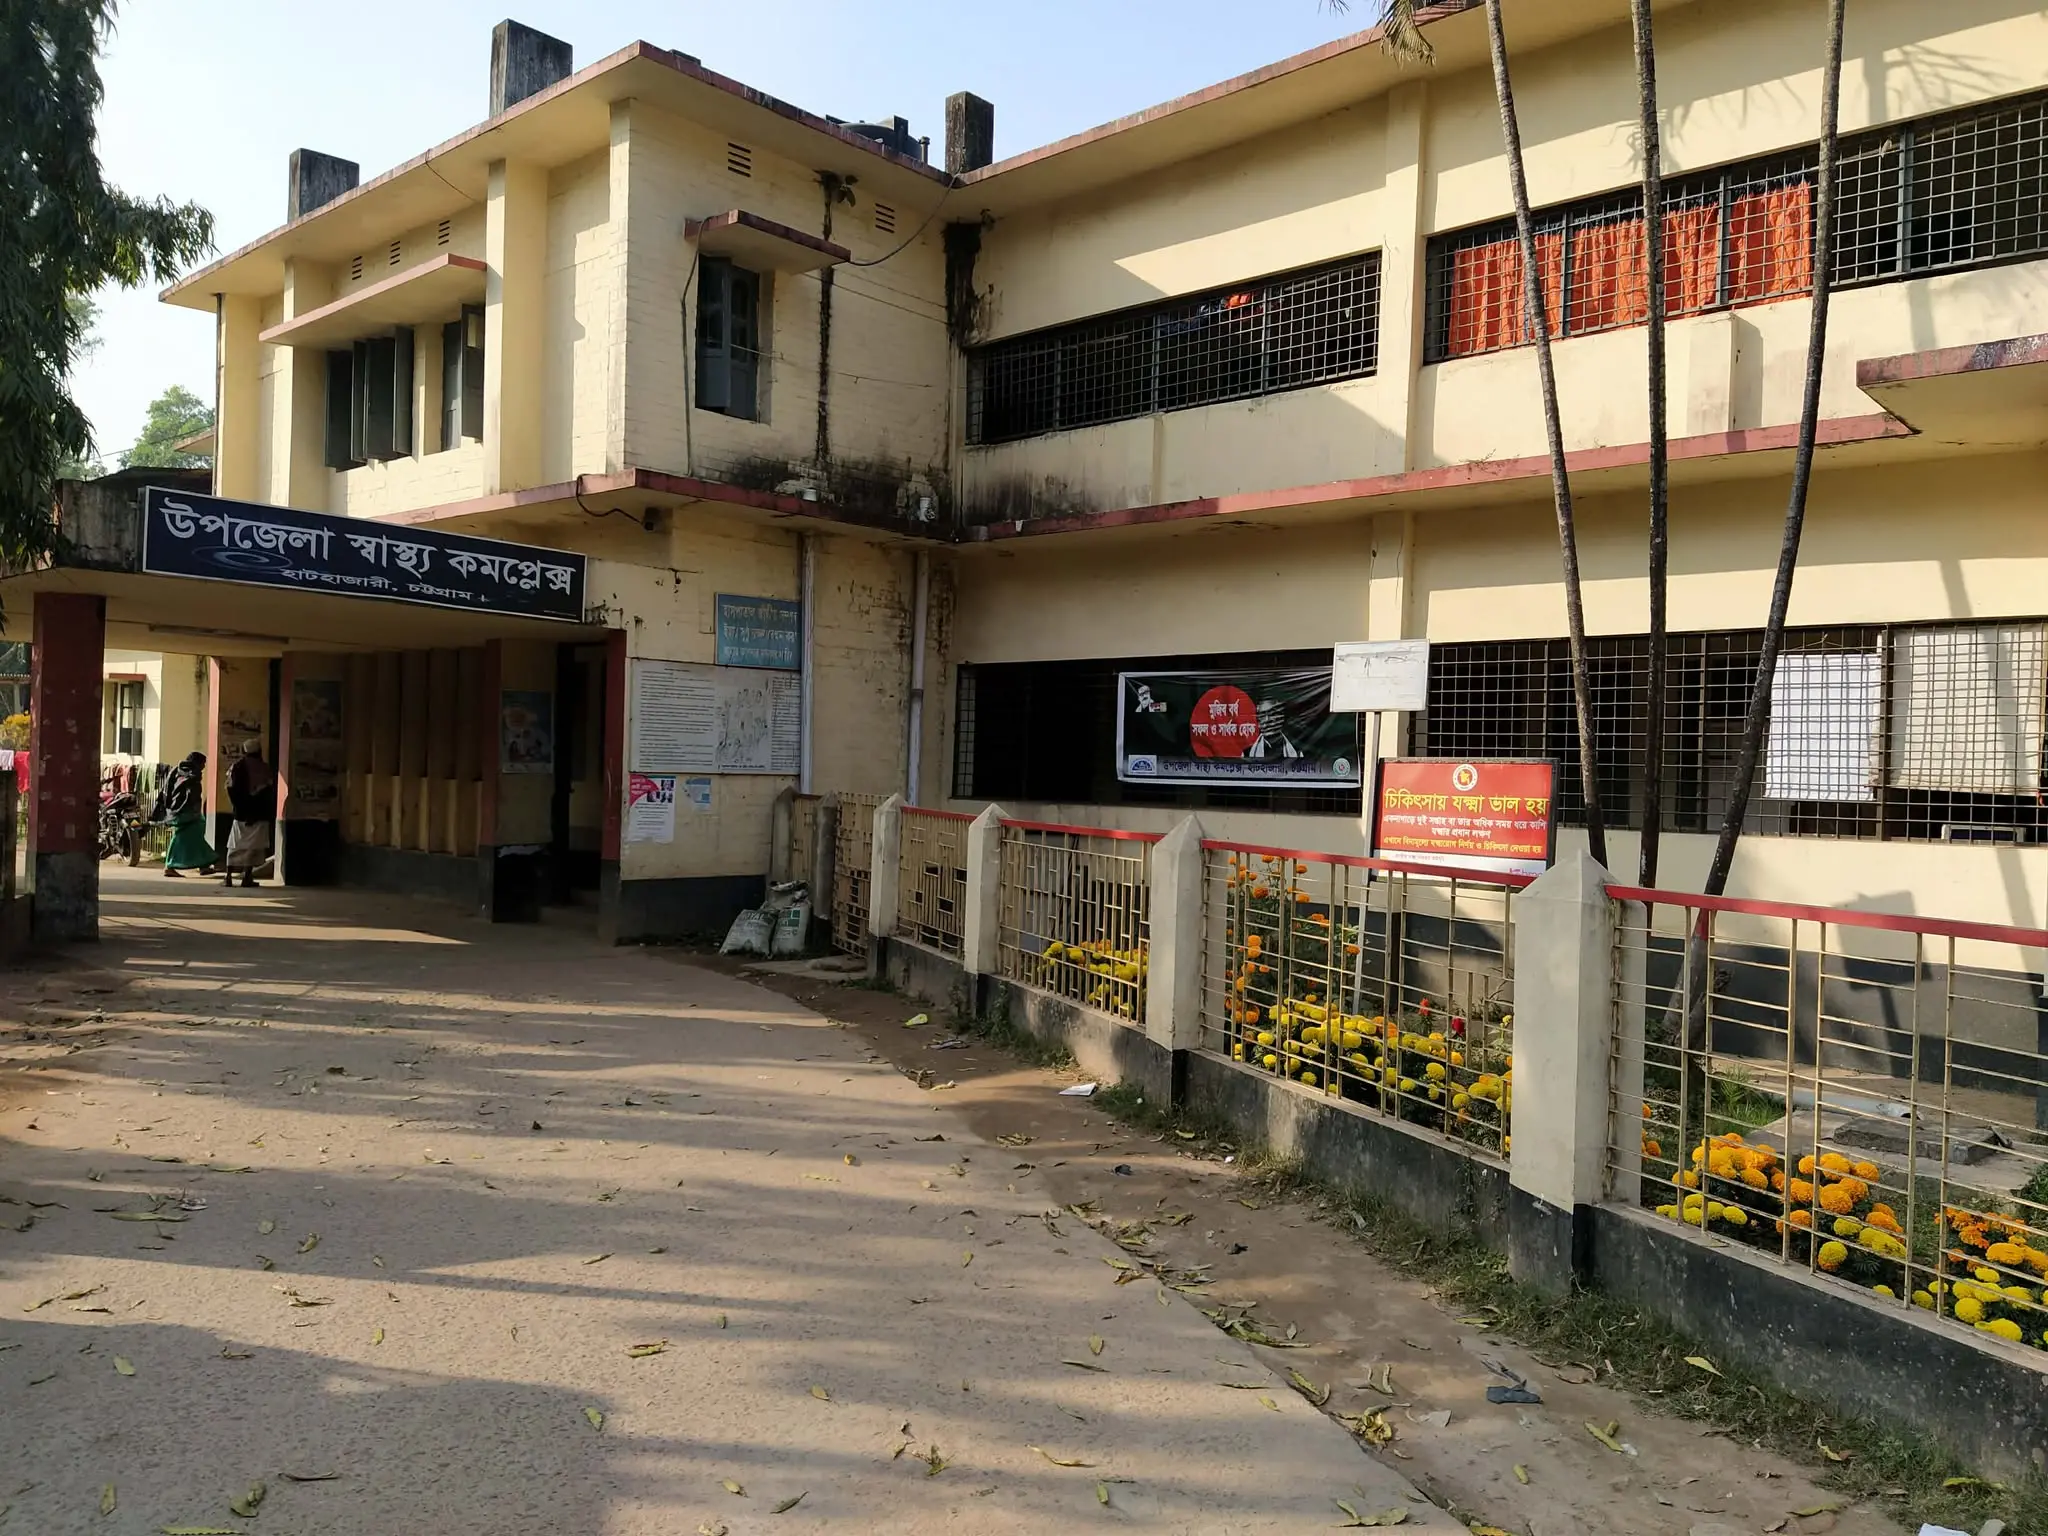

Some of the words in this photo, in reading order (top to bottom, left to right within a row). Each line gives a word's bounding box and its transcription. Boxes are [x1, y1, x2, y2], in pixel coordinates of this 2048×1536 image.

[159, 497, 336, 560] উপজেলা
[345, 533, 438, 580] স্বাস্থ্য
[444, 549, 577, 596] কমপ্লেক্স
[280, 568, 398, 591] হাটহাজারী,
[406, 582, 474, 601] চট্টগ্রাম
[1208, 699, 1227, 720] মুজিব
[1210, 724, 1217, 736] ও
[1385, 788, 1449, 812] চিকিৎসায়
[1488, 794, 1522, 815] ভাল
[1524, 797, 1549, 817] হয়
